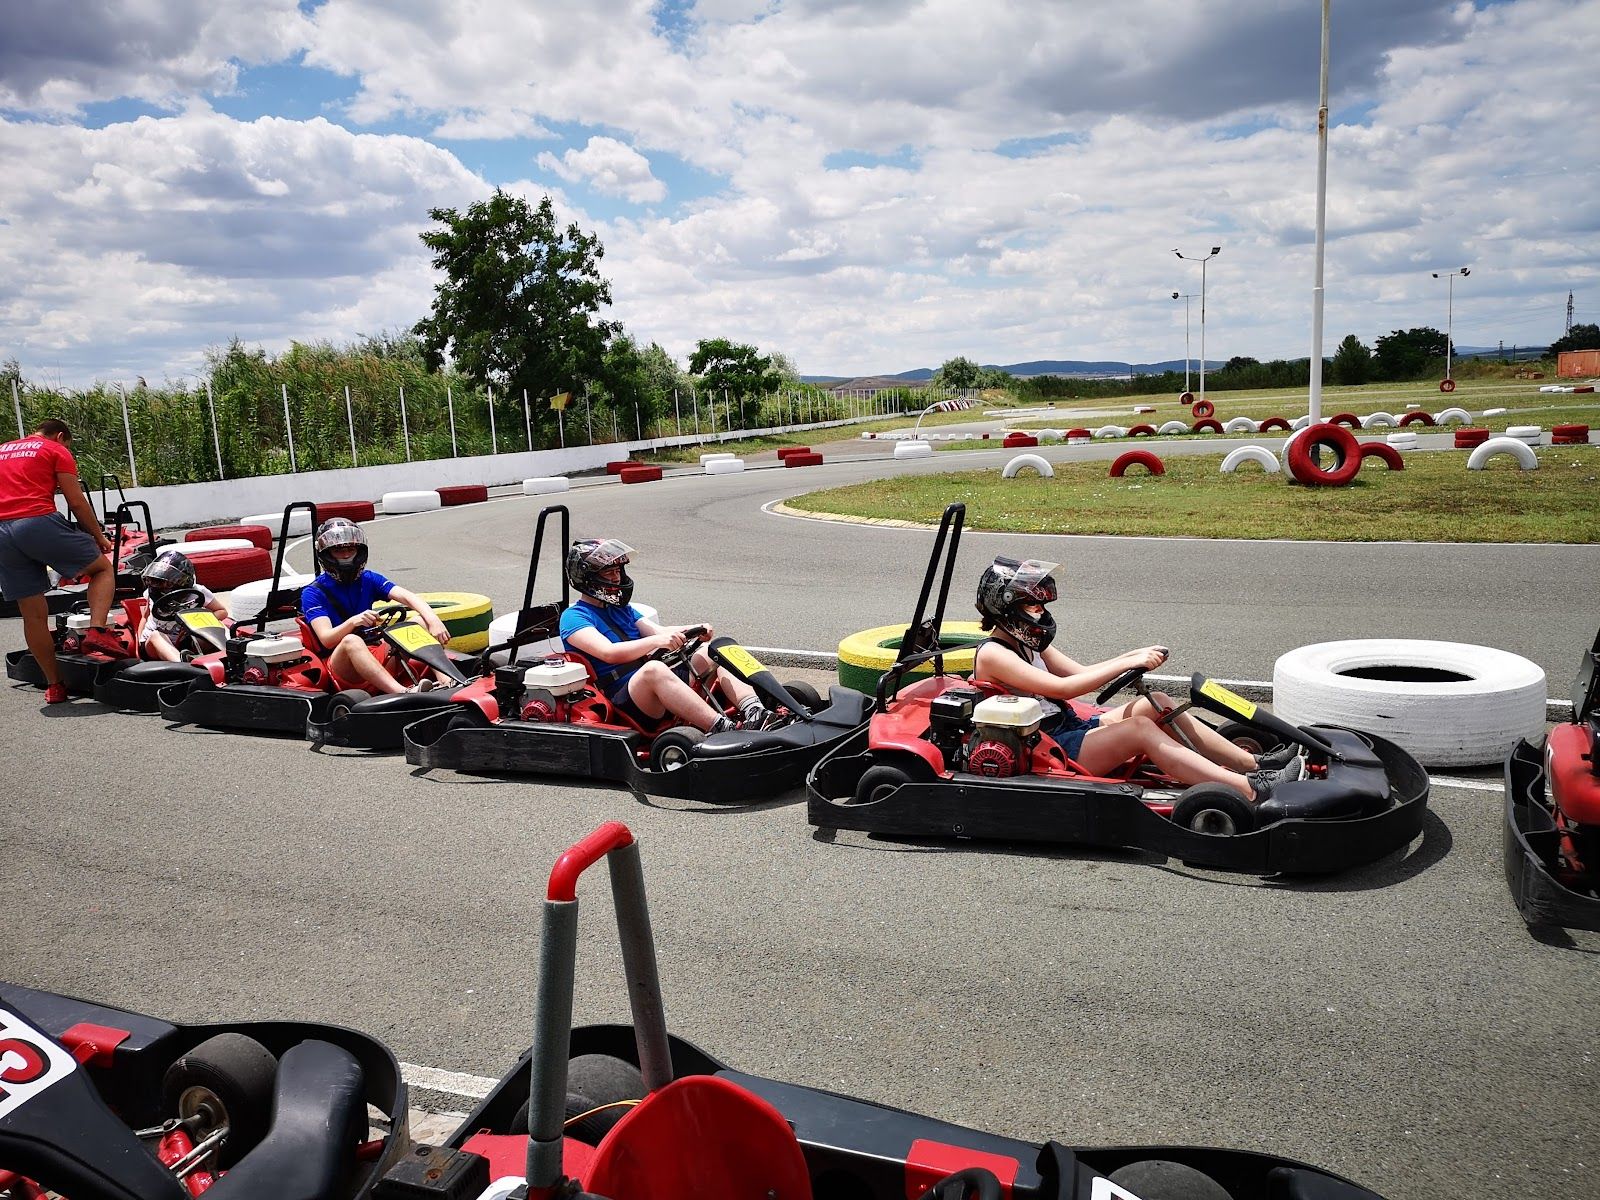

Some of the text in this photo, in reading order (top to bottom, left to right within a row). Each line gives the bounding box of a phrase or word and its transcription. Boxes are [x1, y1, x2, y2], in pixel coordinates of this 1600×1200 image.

[10, 450, 38, 459] BEACH
[406, 627, 431, 645] 4
[728, 646, 760, 670] 9
